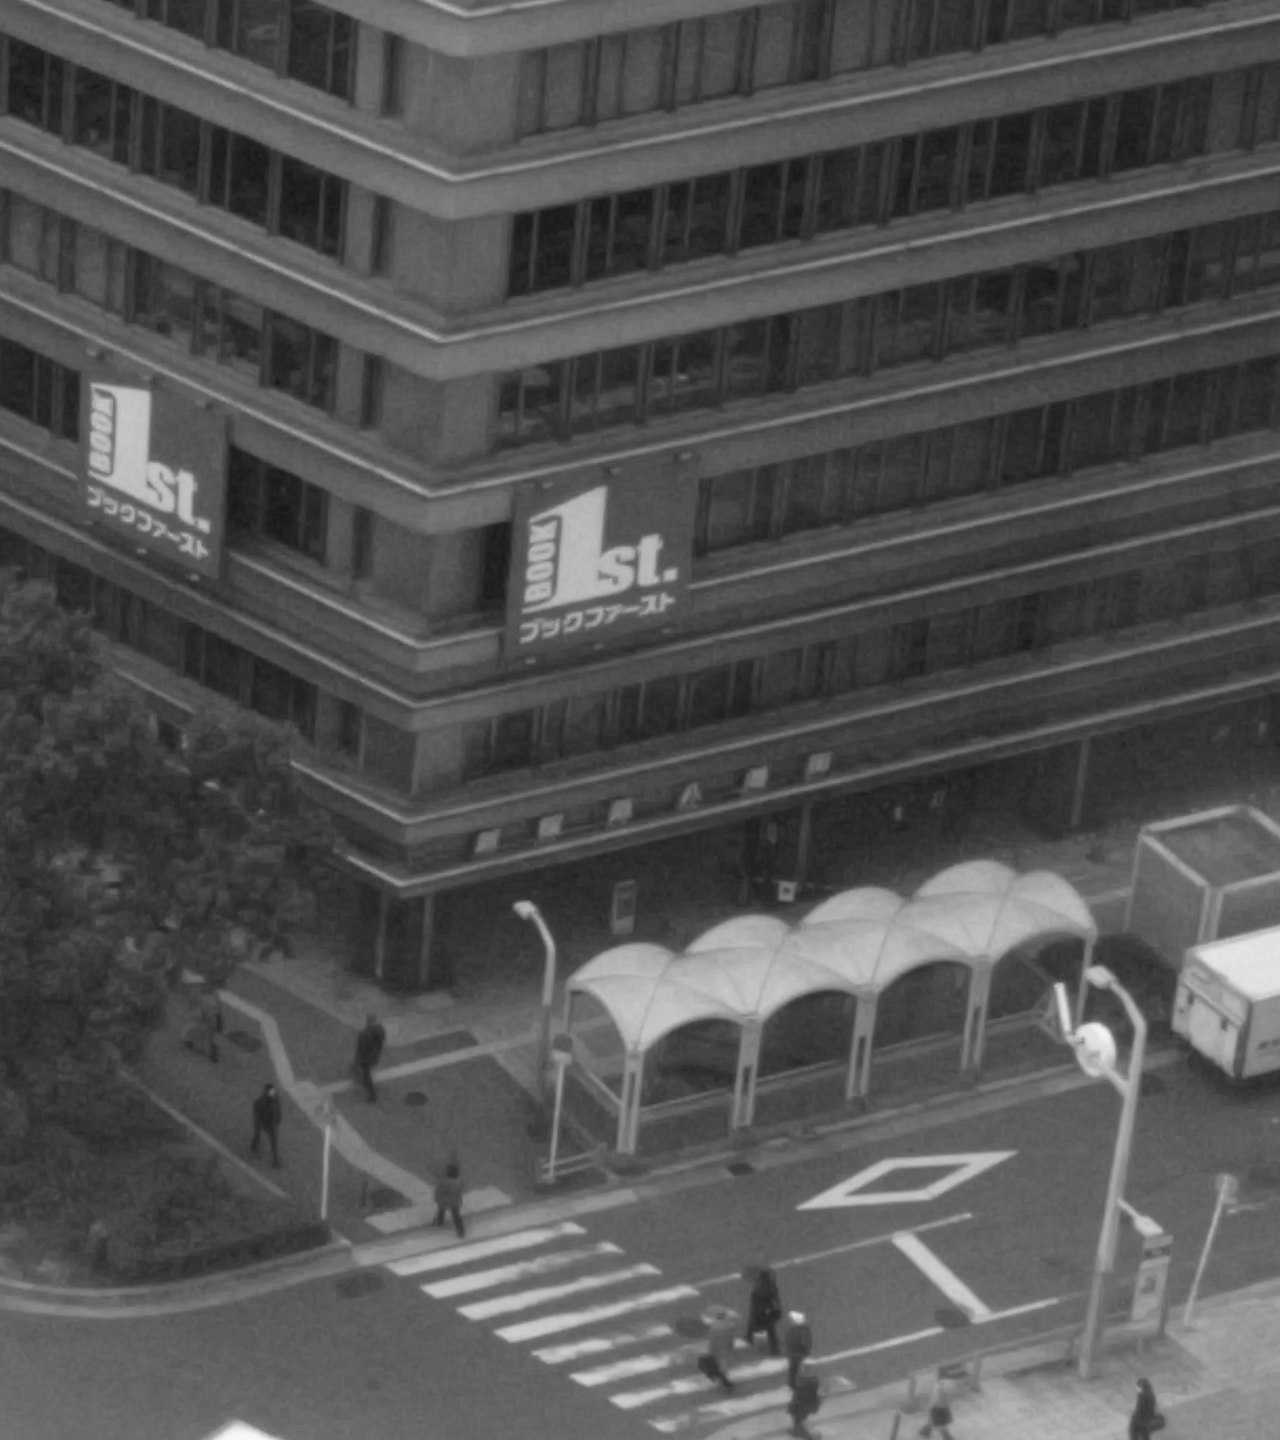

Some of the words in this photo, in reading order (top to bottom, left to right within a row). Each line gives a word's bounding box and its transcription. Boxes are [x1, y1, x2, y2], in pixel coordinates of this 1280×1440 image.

[89, 390, 114, 475] BOOK
[87, 485, 209, 560] ブックファースト
[524, 518, 559, 604] BOOK
[519, 592, 676, 644] ブックファースト
